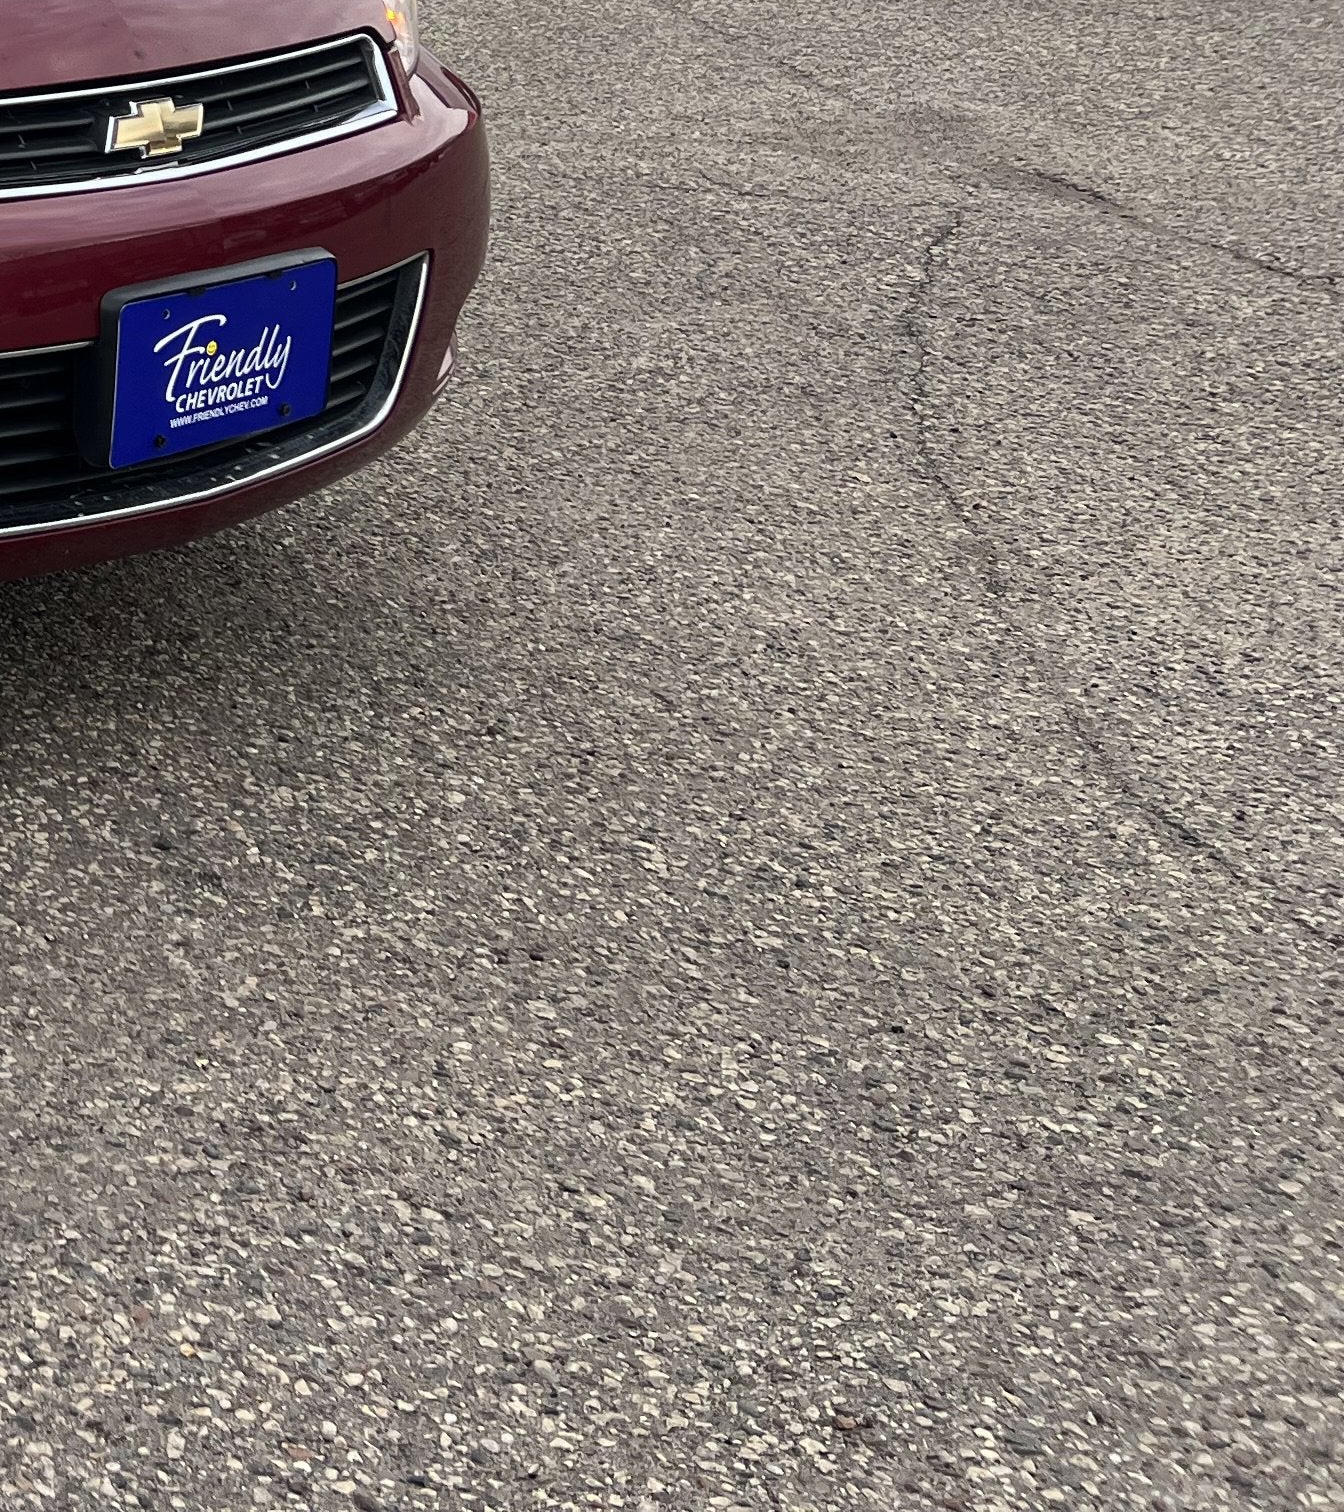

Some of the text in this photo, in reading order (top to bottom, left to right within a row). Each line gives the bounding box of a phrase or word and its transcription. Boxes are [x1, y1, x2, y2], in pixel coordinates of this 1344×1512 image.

[153, 314, 292, 402] Friendly
[169, 395, 269, 429] WWW.FRIENDLYCHEV.COM
[175, 375, 265, 413] CHEVROLET
